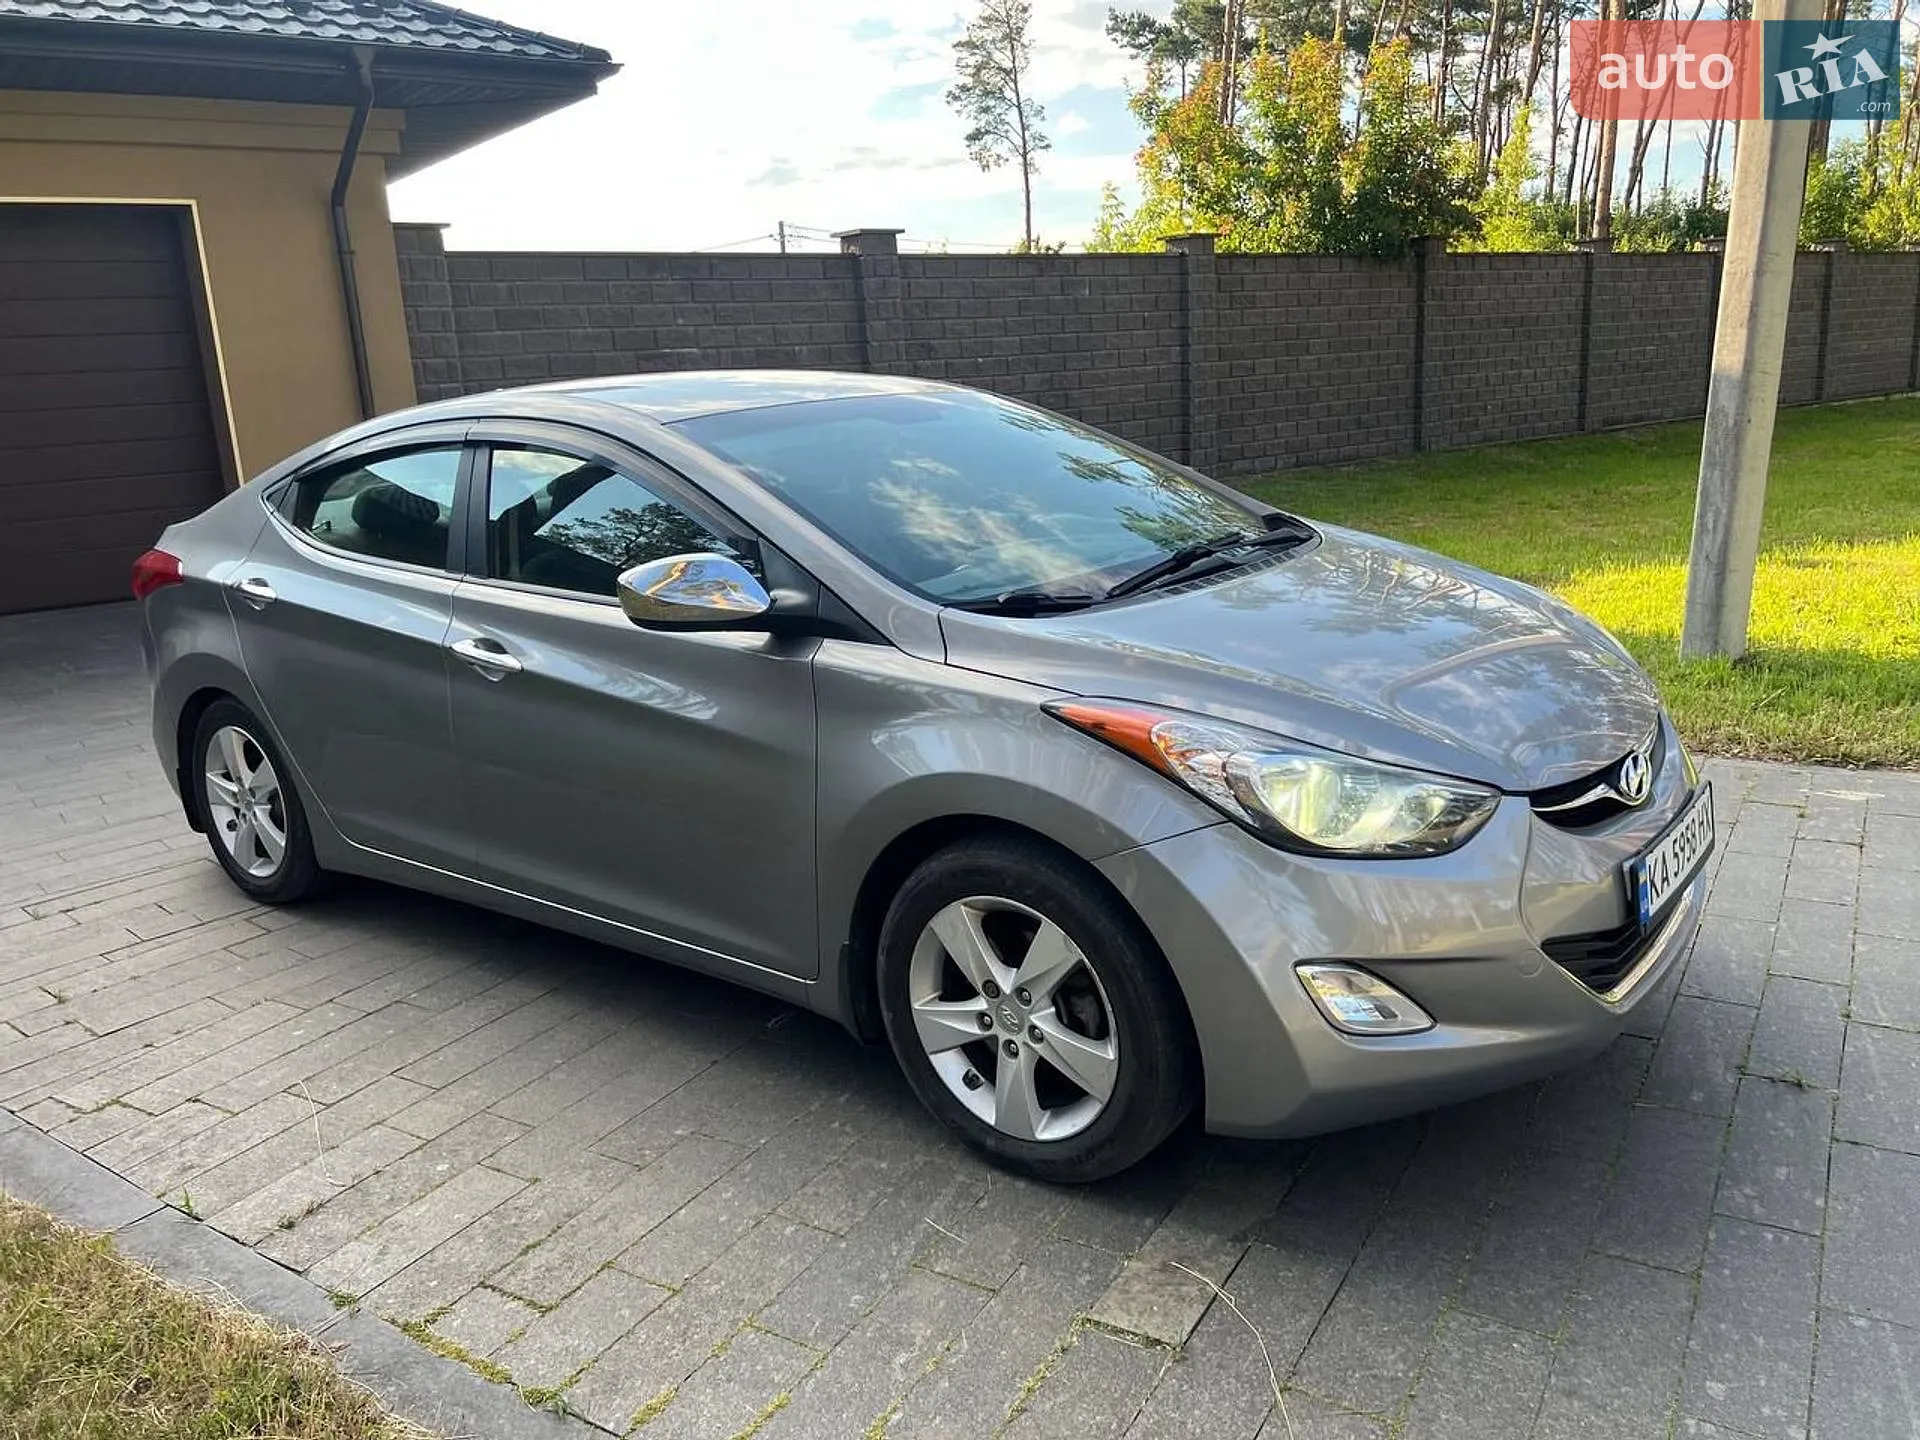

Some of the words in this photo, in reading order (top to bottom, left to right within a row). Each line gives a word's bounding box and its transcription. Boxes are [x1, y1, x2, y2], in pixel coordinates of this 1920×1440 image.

[1648, 851, 1670, 904] KA
[1672, 818, 1697, 878] 5958
[1698, 799, 1711, 846] HX
